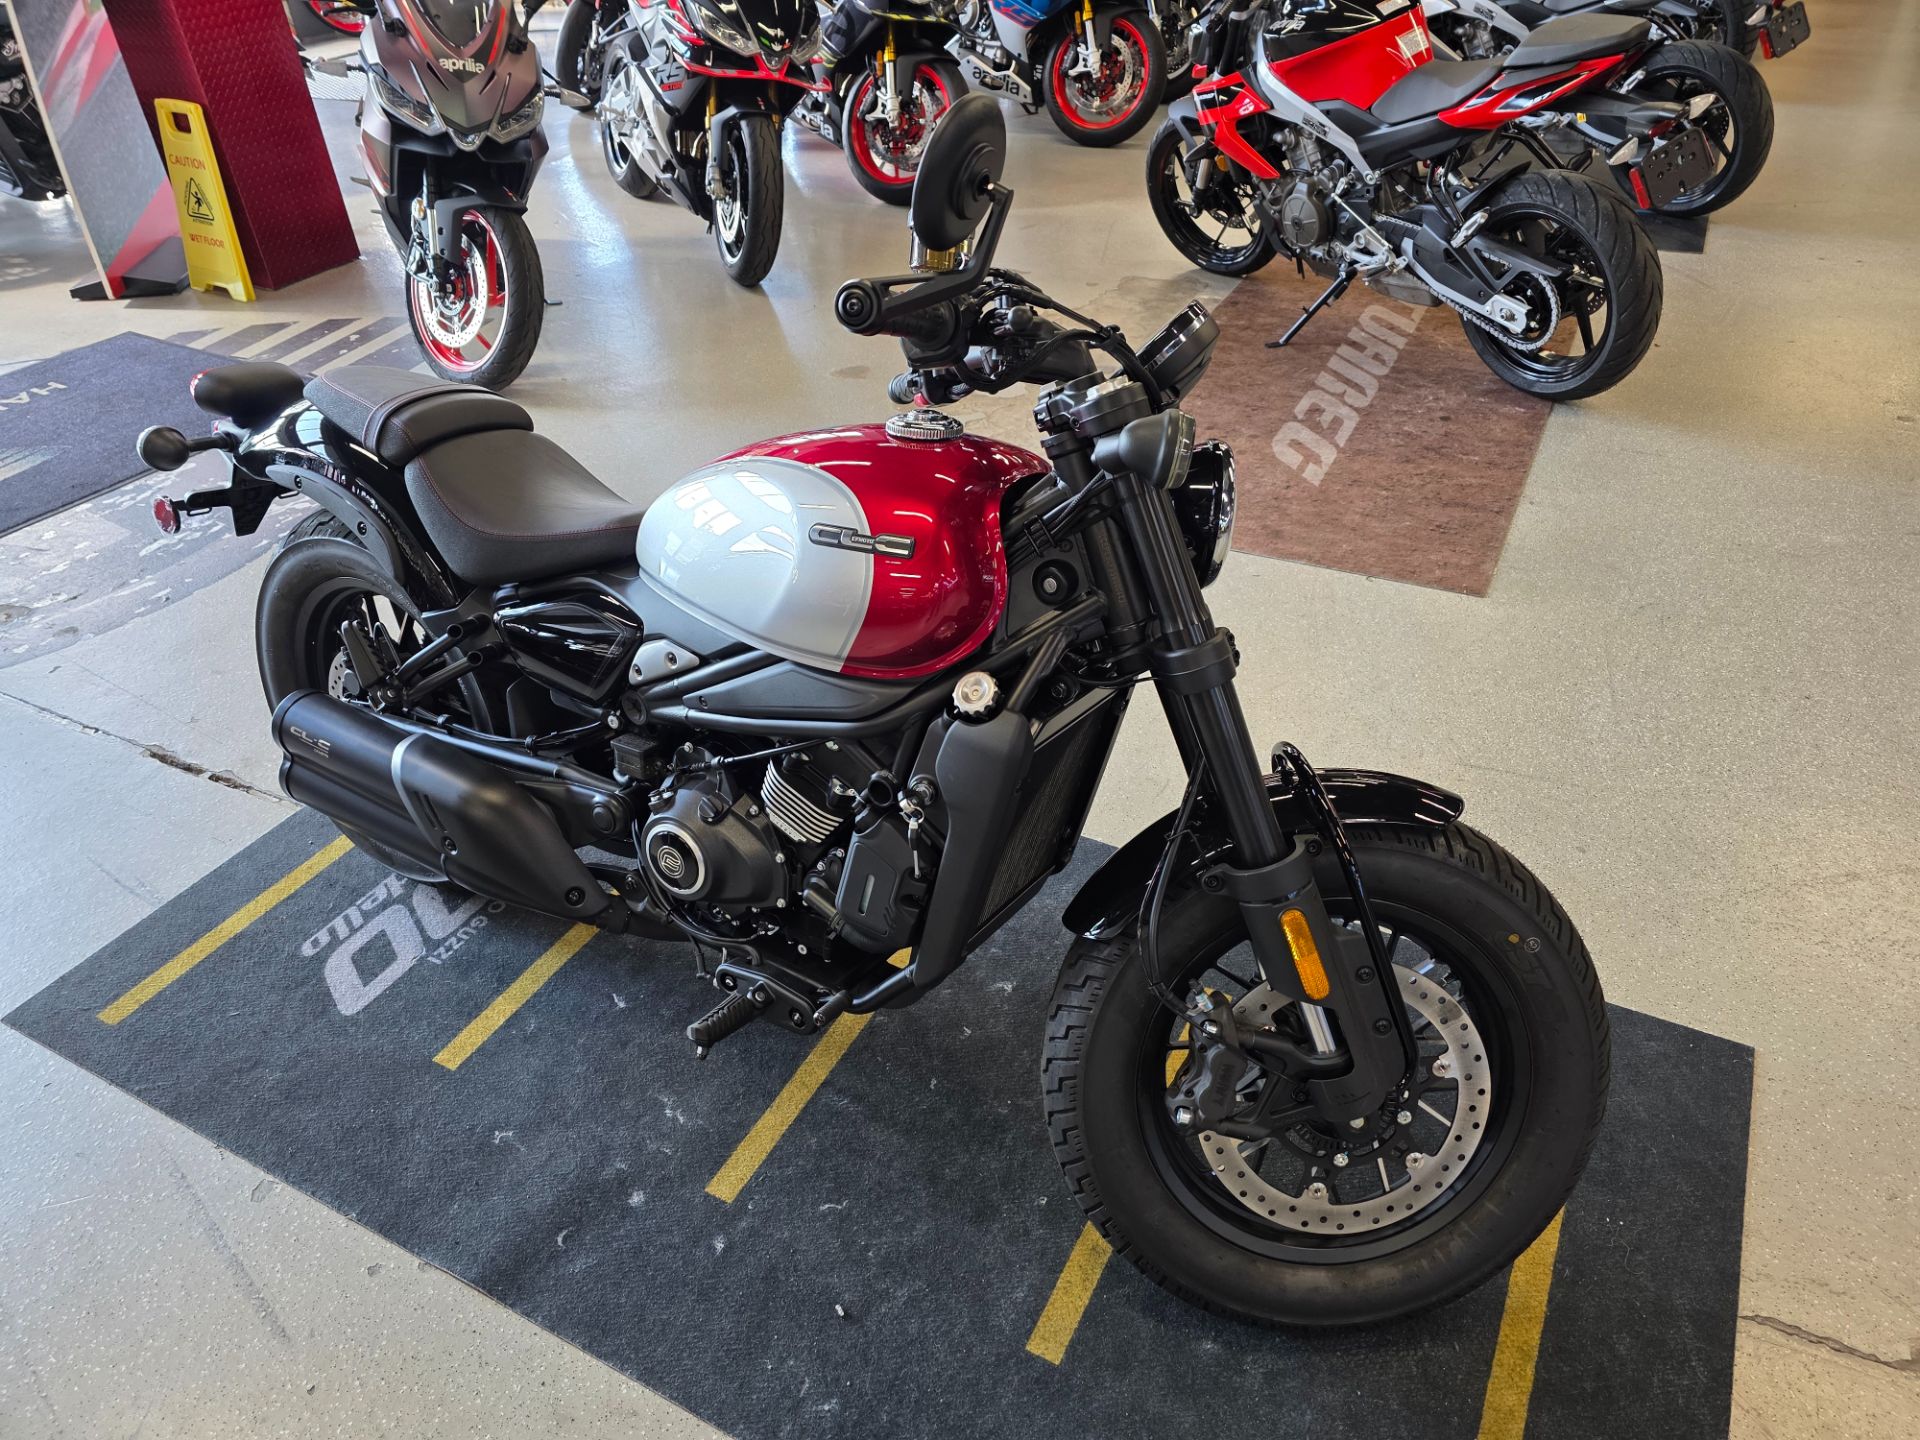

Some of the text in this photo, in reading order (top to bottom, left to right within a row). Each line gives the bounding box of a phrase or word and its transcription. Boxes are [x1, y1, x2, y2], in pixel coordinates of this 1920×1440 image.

[439, 58, 485, 74] aprilia
[168, 154, 206, 171] CAUTION
[190, 233, 226, 249] WET FLOOR
[426, 915, 489, 965] GUZZI
